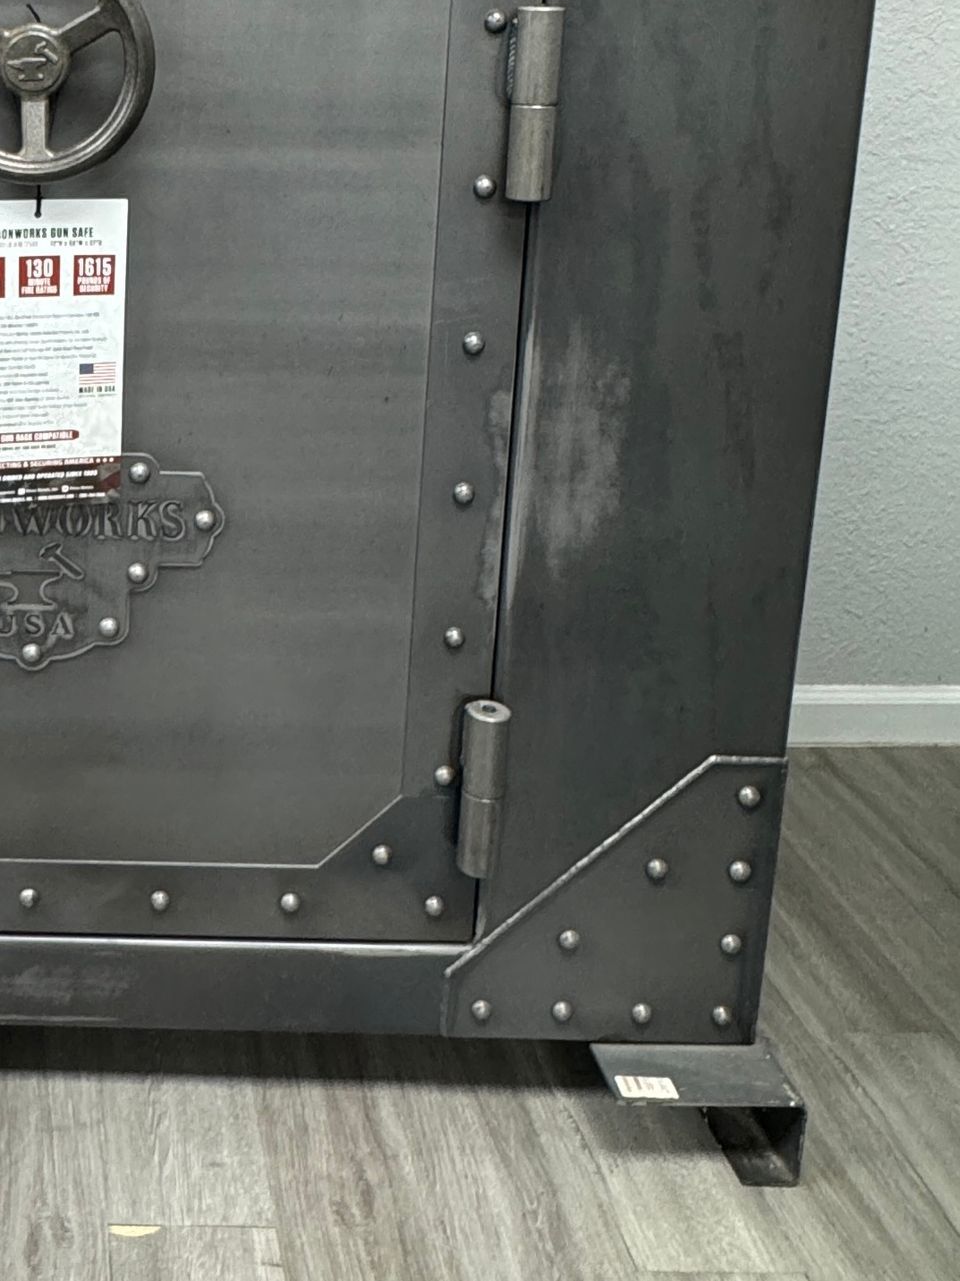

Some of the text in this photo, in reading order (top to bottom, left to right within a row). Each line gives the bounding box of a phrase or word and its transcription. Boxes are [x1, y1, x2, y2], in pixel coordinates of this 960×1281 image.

[50, 227, 69, 239] GUN
[72, 227, 94, 239] SAFE
[25, 258, 54, 278] 130
[77, 257, 112, 277] 1615
